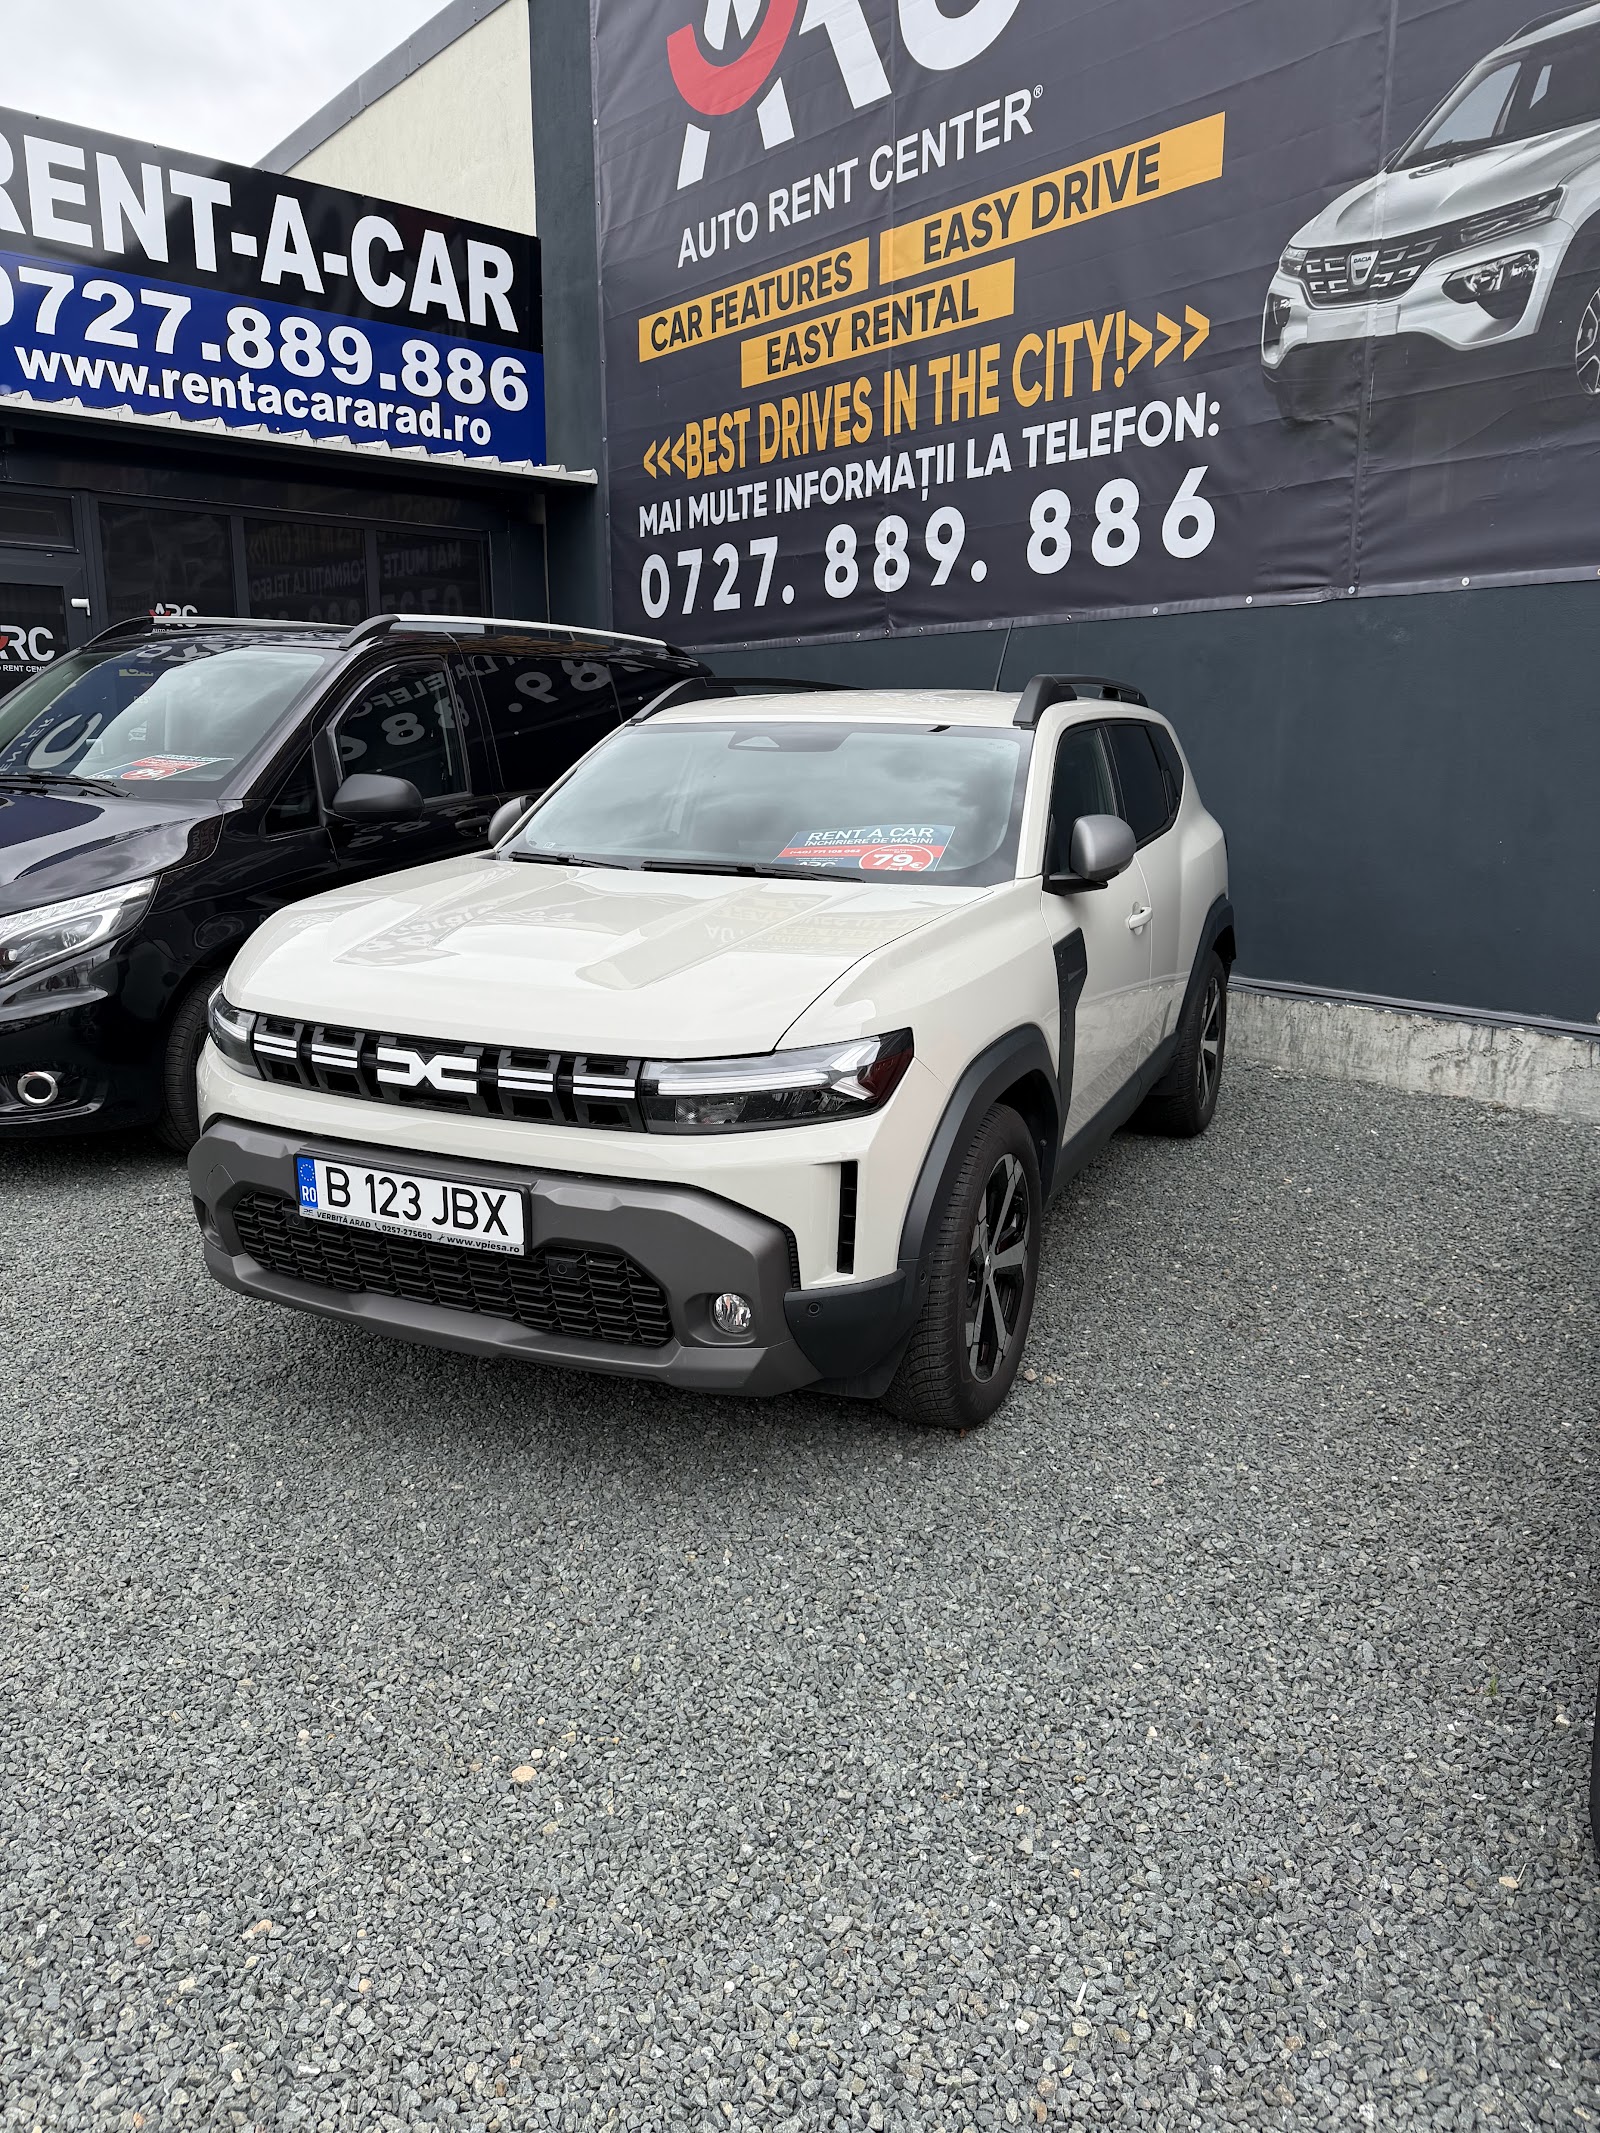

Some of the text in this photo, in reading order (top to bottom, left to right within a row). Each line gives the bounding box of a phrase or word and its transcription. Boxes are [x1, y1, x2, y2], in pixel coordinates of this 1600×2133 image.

[677, 208, 759, 268] AUTO
[769, 157, 858, 232] RENT
[924, 142, 1161, 262] EASY DRIVE
[0, 266, 528, 412] 727.889.886
[651, 252, 852, 352] CAR FEATURES
[767, 278, 979, 375] EASY RENTAL
[14, 345, 492, 446] www.rentacararad.ro
[766, 376, 874, 465] DRIVES
[883, 364, 917, 437] IN
[929, 344, 1001, 423] THE
[639, 500, 682, 538] MAI
[690, 480, 768, 530] MULTE
[967, 433, 1011, 478] LA
[1022, 392, 1221, 468] TELEFON:
[641, 466, 1216, 619] 0727. 889. 886
[2, 664, 24, 672] RENT
[807, 827, 935, 841] RENT A CAR
[302, 1185, 317, 1203] RO
[325, 1166, 509, 1236] B 123 JBX
[349, 1218, 371, 1229] ARAD
[446, 1236, 520, 1254] www.vpiesa.ro
